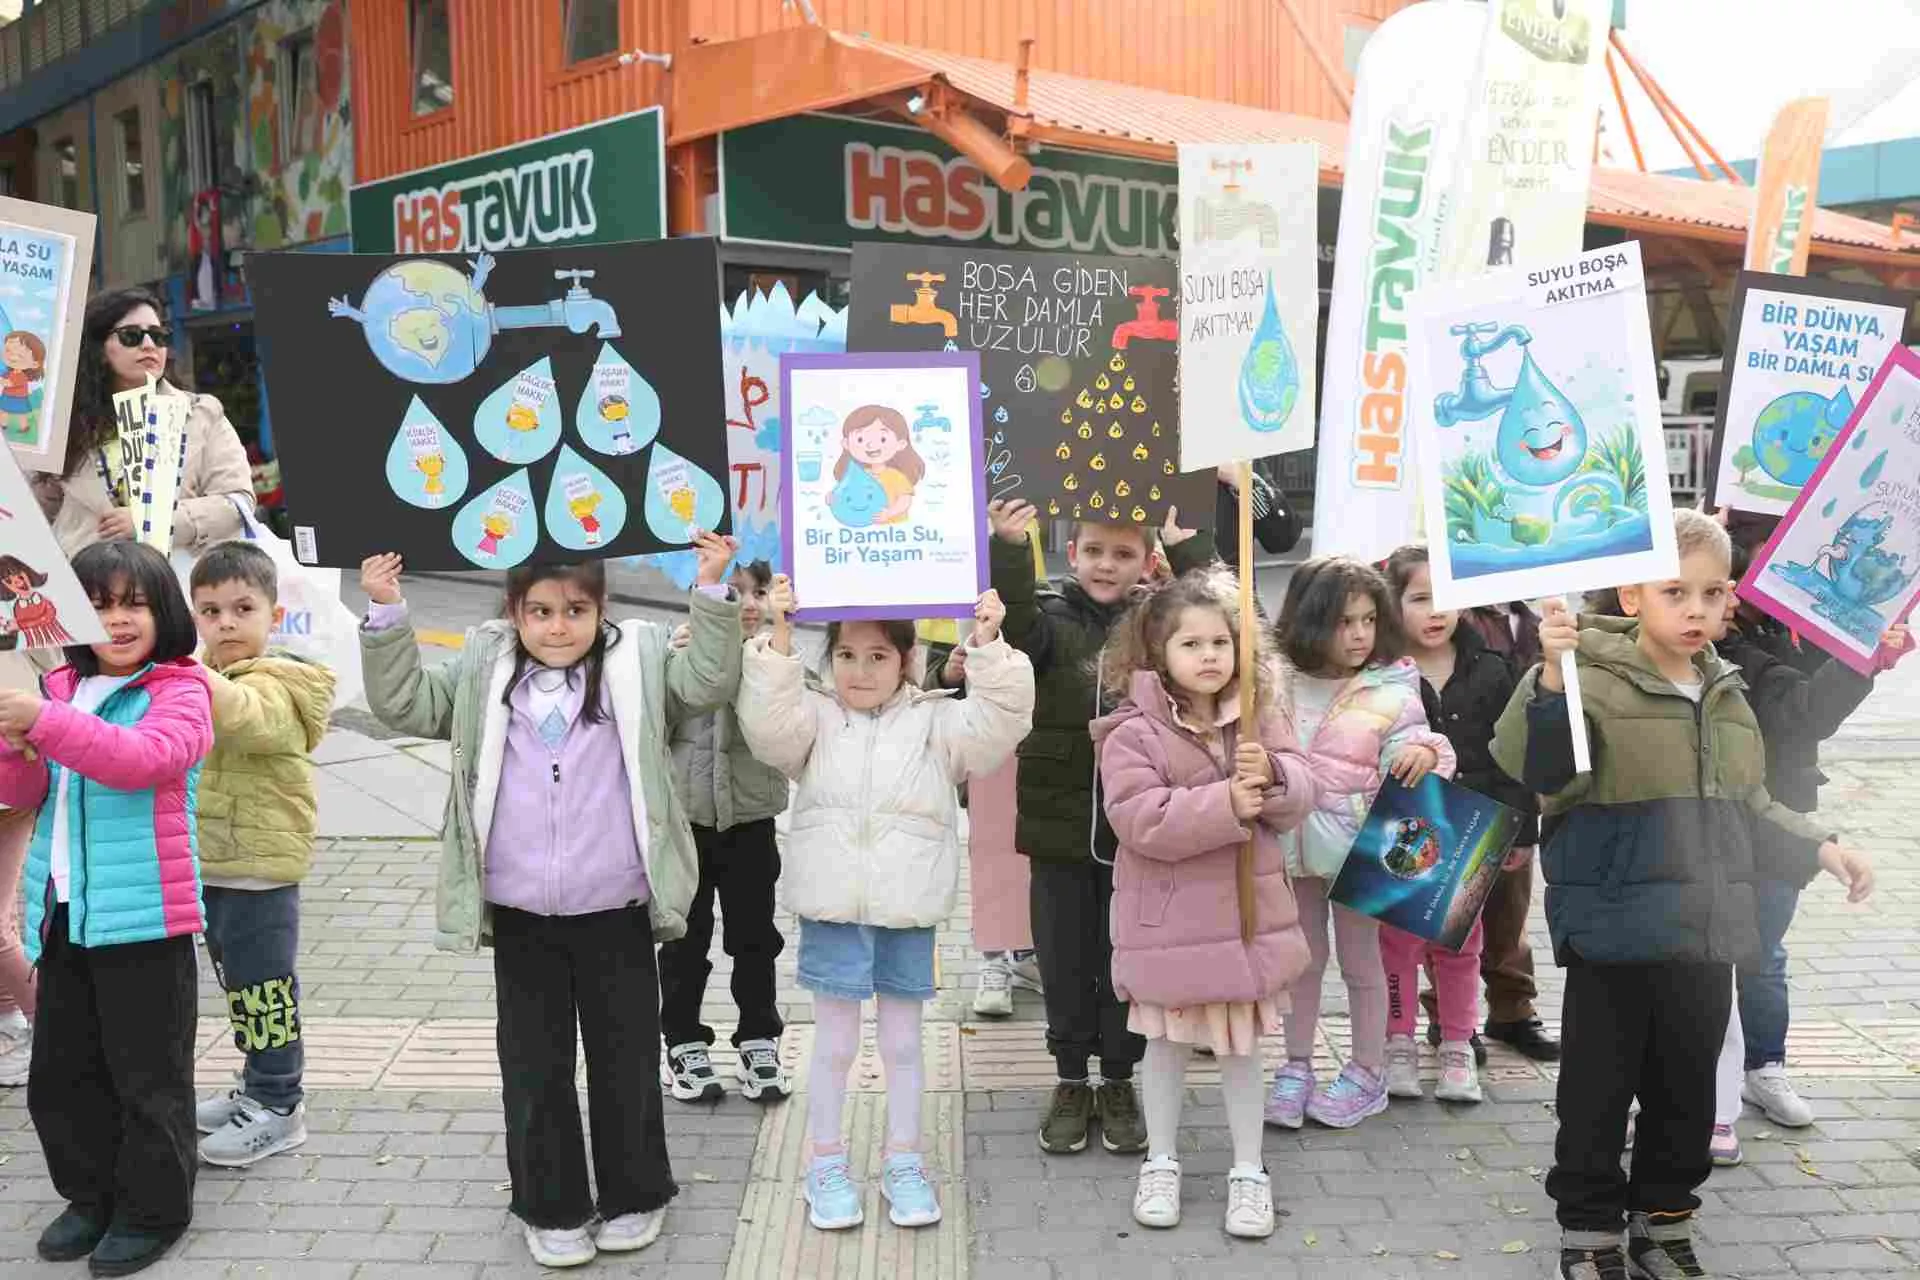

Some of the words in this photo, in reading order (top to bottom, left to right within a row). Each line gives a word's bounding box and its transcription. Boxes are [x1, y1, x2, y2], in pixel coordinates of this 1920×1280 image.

[26, 242, 51, 261] SU
[963, 261, 1037, 293] BOŞA
[1053, 260, 1128, 297] GİDEN
[1527, 265, 1574, 287] SUYU
[1579, 252, 1628, 275] BOŞA
[1185, 271, 1225, 305] SUYU
[1546, 277, 1615, 304] AKITMA
[959, 292, 1008, 322] HER
[1023, 297, 1103, 327] DAMLA
[1762, 300, 1798, 326] BİR
[1804, 305, 1885, 340] DÜNYA,
[1783, 330, 1859, 358] YAŞAM
[1747, 348, 1779, 371] BİR
[1783, 356, 1851, 381] DAMLA
[805, 528, 833, 546] Bir
[839, 526, 907, 545] Damla
[913, 525, 944, 544] Su,
[825, 547, 852, 565] Bir
[857, 546, 924, 567] Yaşam
